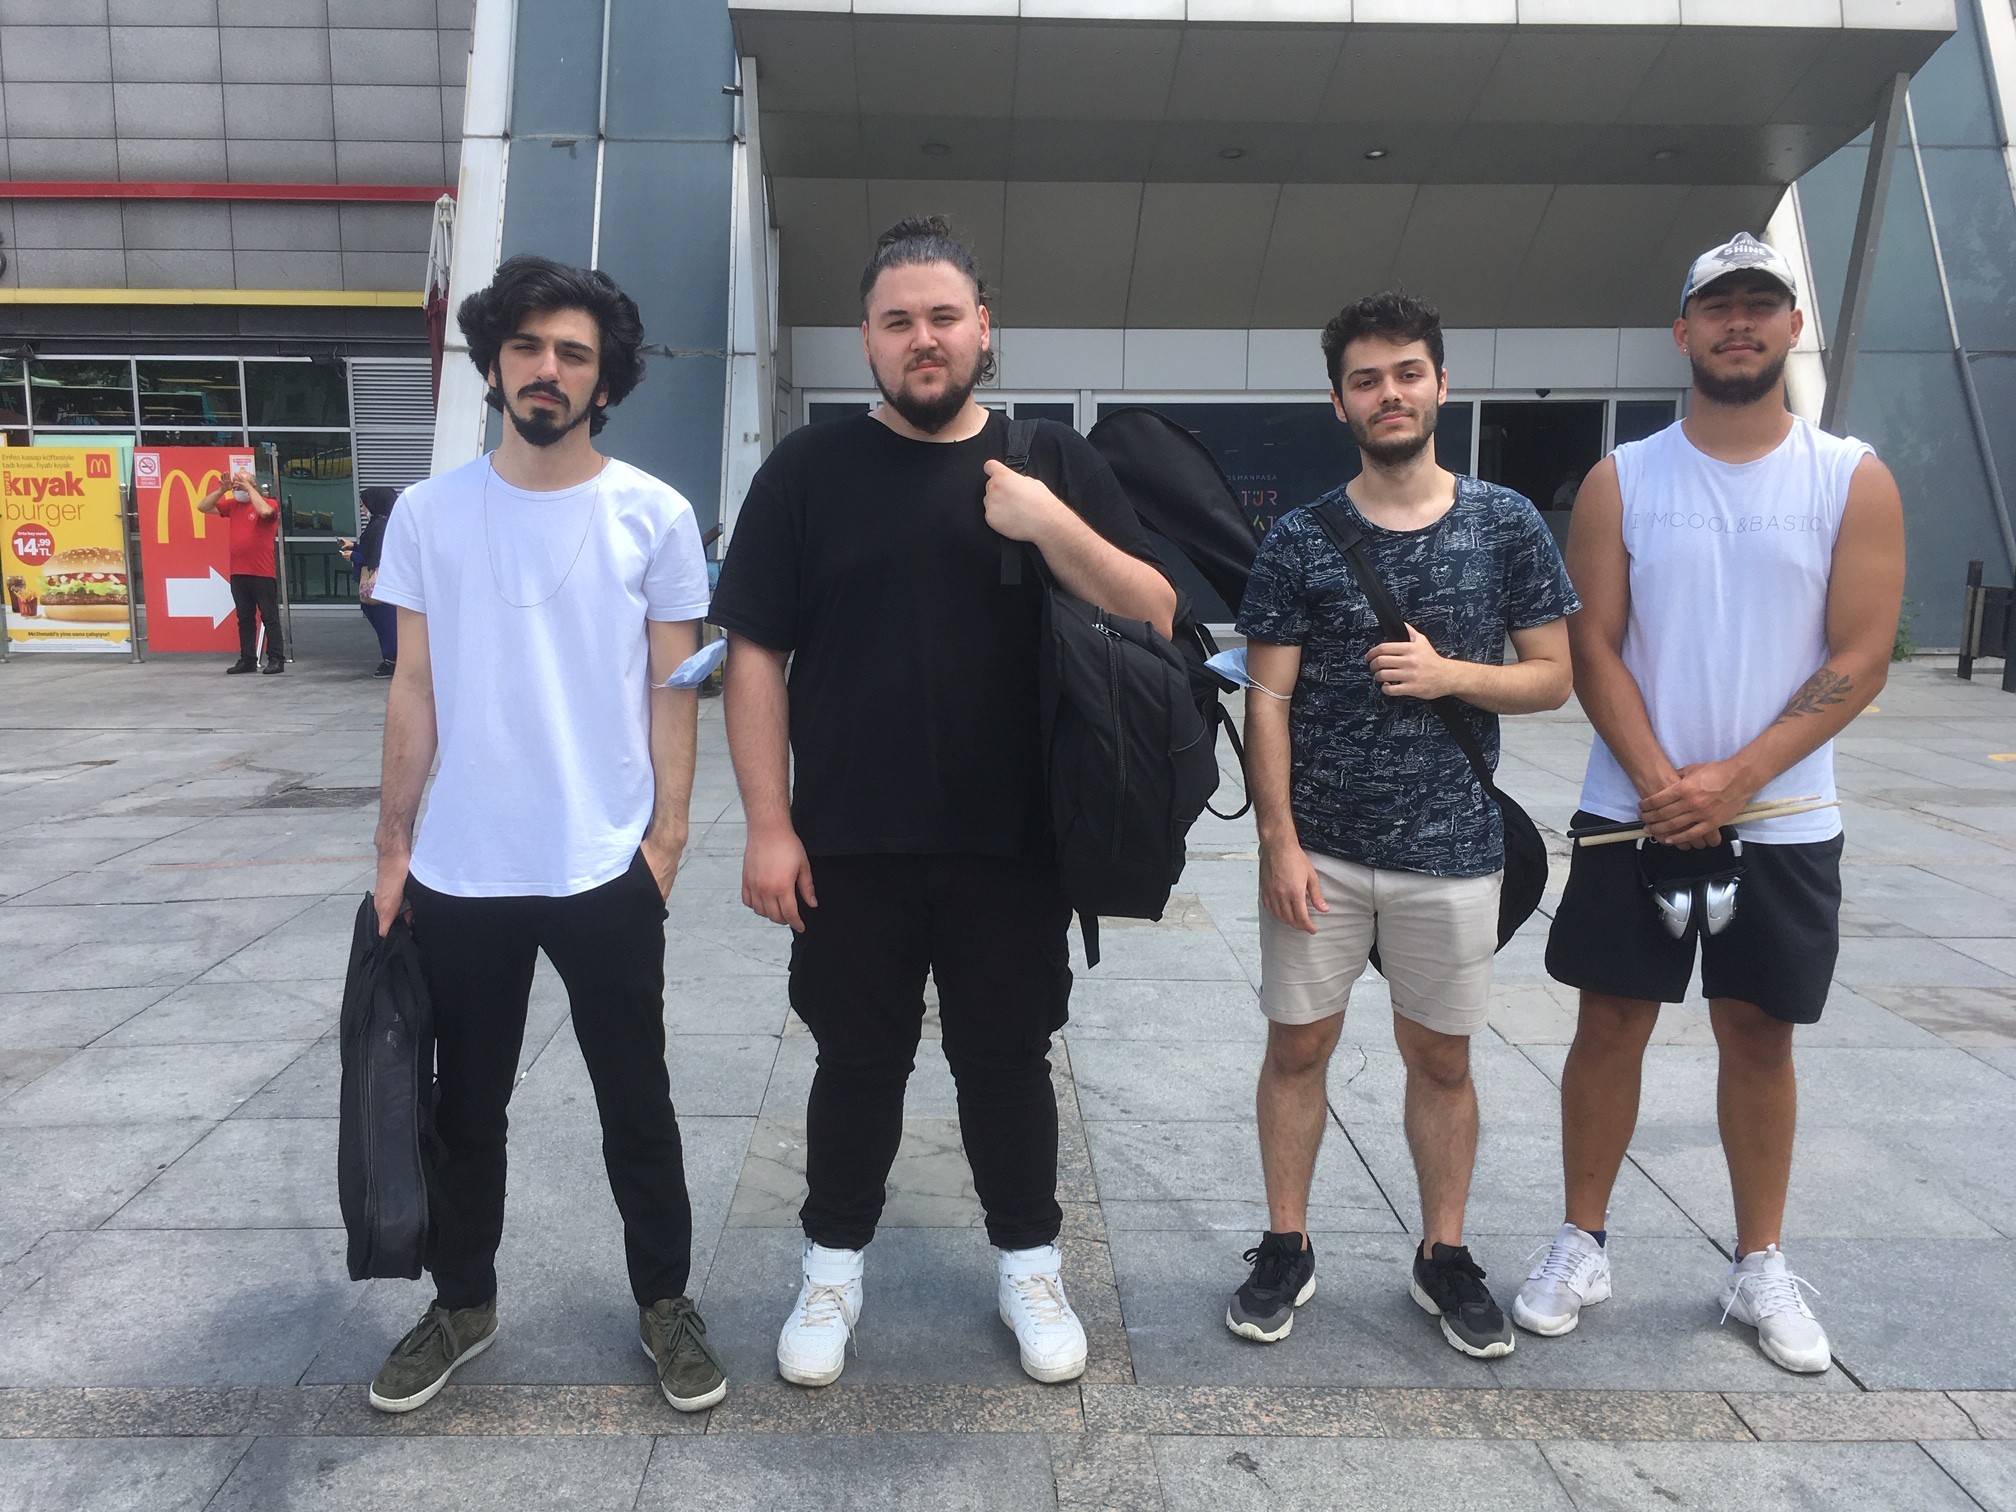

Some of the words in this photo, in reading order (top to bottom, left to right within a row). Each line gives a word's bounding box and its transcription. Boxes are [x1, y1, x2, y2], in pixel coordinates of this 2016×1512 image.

[1723, 245, 1767, 256] SHINE
[3, 471, 86, 502] kıyak
[5, 498, 85, 527] burger
[39, 547, 52, 556] TL
